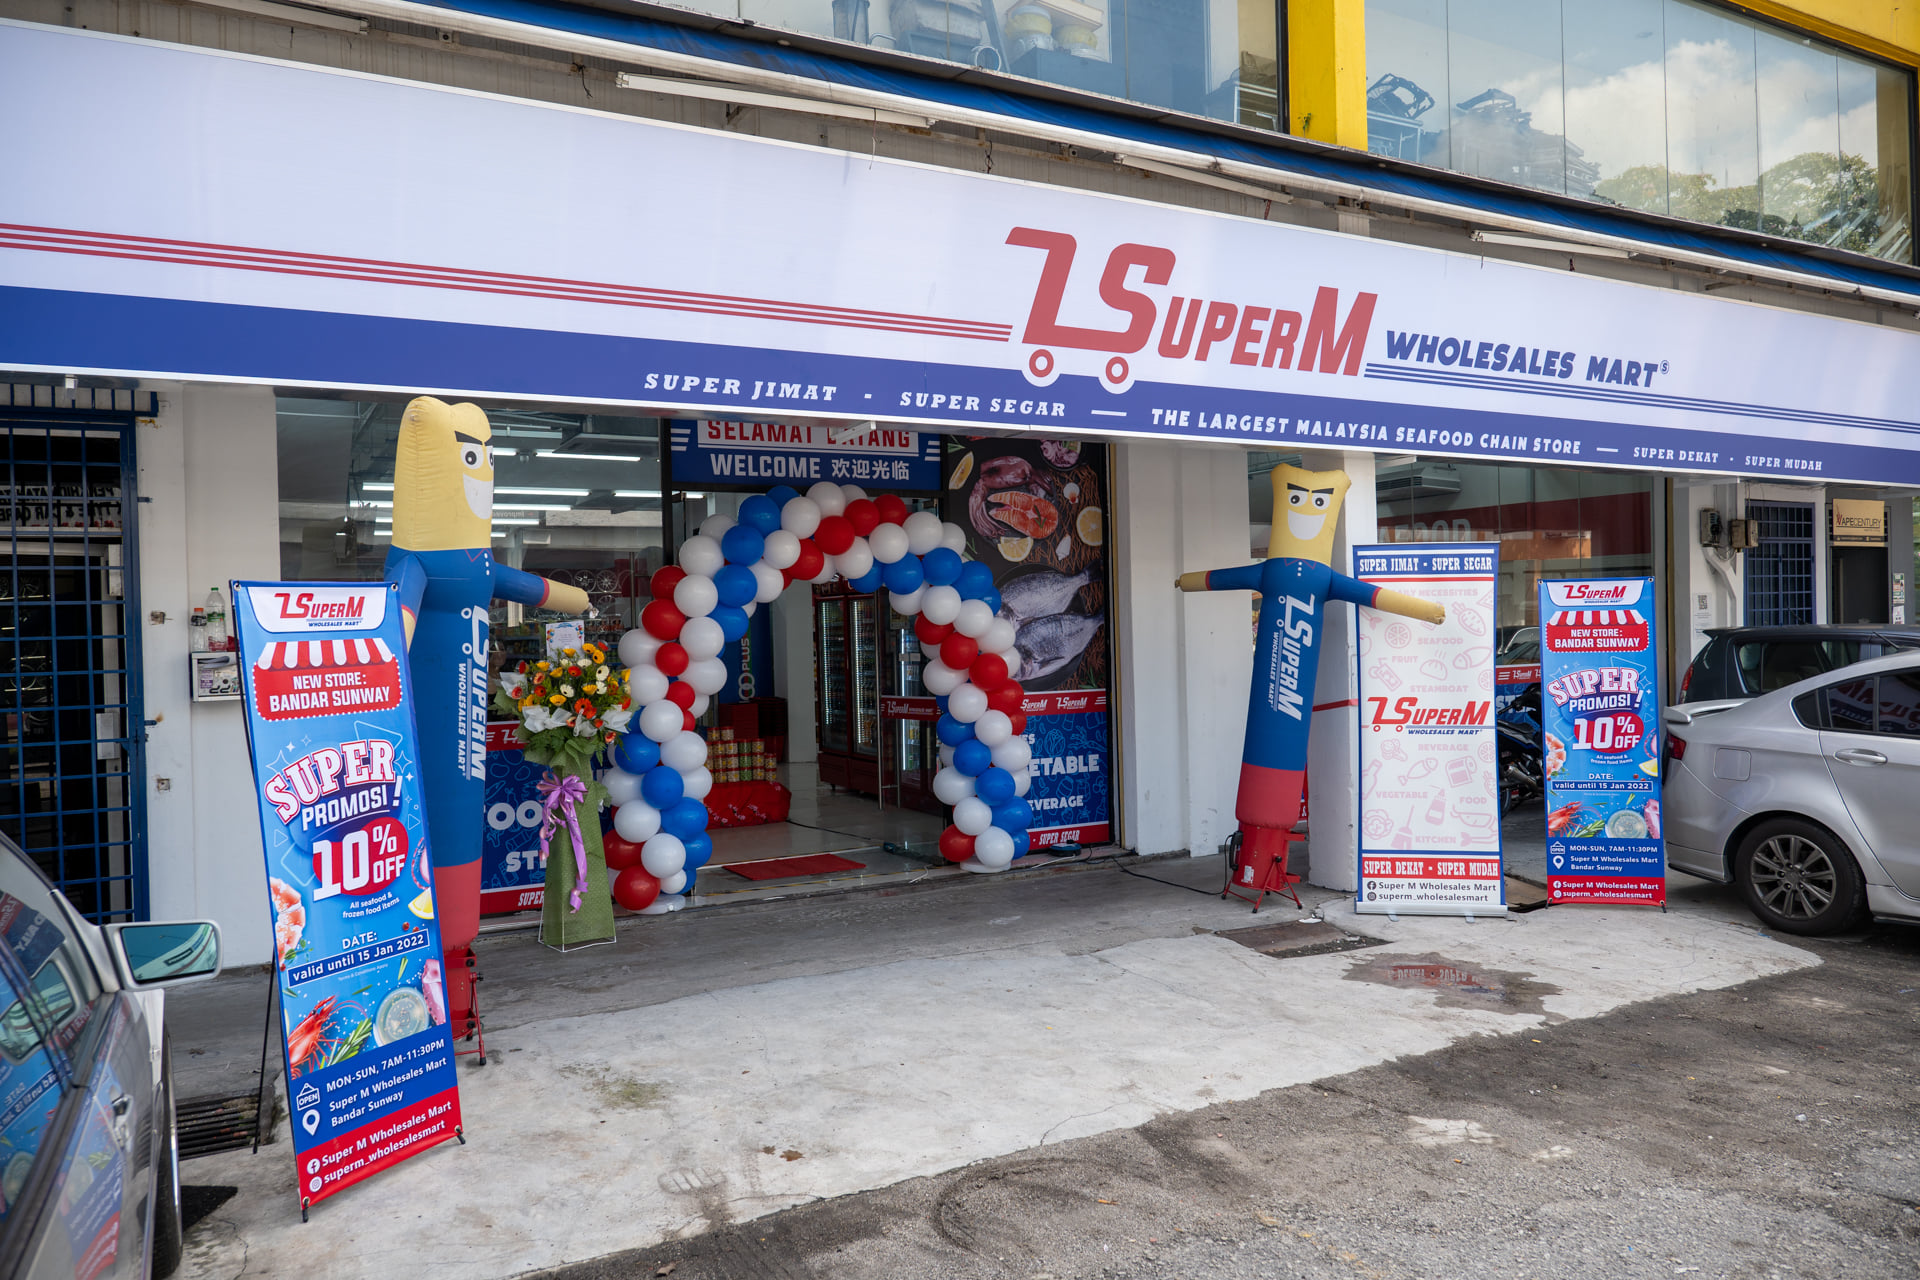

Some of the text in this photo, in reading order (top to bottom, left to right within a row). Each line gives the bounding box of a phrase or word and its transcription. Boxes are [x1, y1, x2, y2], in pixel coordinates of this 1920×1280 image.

[1386, 329, 1576, 380] WHOLESALES
[644, 373, 1823, 471] SUPER JIMAT SUPER SEGAR THE LARGEST MALAYSIA SEAFOOD CHAIN STORE SUPER DEKAT SUPER MUDAH
[710, 453, 821, 479] WELCOME
[831, 458, 910, 481] 欢迎光临
[1359, 557, 1492, 572] SUPER JIMAT SUPER SEGAR
[1418, 588, 1478, 596] NECESSITIES
[1417, 637, 1463, 645] SEAFOOD
[1571, 628, 1623, 637] NEW STORE:
[1555, 637, 1640, 648] BANDAR SUNWAY
[1270, 632, 1279, 680] WHOLESALES
[293, 671, 367, 690] NEW STORE:
[1547, 667, 1640, 707] SUPER
[269, 686, 390, 713] BANDAR SUNWAY
[458, 663, 466, 735] WHOLESALES
[1418, 743, 1469, 751] BEVERAGE
[1614, 735, 1641, 749] OFF
[1029, 754, 1100, 777] ETABLE
[264, 739, 395, 825] SUPER
[1027, 795, 1084, 811] EVERAGE
[1376, 791, 1428, 799] VEGETABLE
[1039, 832, 1059, 845] SUPER
[1416, 836, 1456, 844] KITCHEN
[1570, 845, 1606, 853] MON-SUN,
[373, 854, 406, 884] OFF
[1364, 861, 1498, 877] SUPER DEKAT SUPER MUDAH
[1379, 882, 1405, 890] Super
[1420, 882, 1471, 890] Wholesales
[1474, 883, 1497, 891] Mart
[1562, 881, 1584, 889] Super
[350, 901, 360, 909] All
[361, 894, 387, 908] seafood
[1379, 893, 1488, 902] superm_wholesalesmart
[1563, 891, 1652, 899] superm_wholesalesmart
[343, 897, 400, 919] frozen food items
[342, 931, 377, 950] DATE:
[293, 934, 424, 982] valid until 15 Jan 2022
[326, 1038, 445, 1093] MON-SUN, 7AM-11:30PM
[329, 1057, 447, 1112] Super M Wholesales Mart
[298, 1093, 318, 1107] OPEN
[331, 1090, 404, 1127] Bandar Sunway
[321, 1101, 452, 1168] Super M Wholesales Mart
[324, 1120, 446, 1184] superm_wholesalesmart
